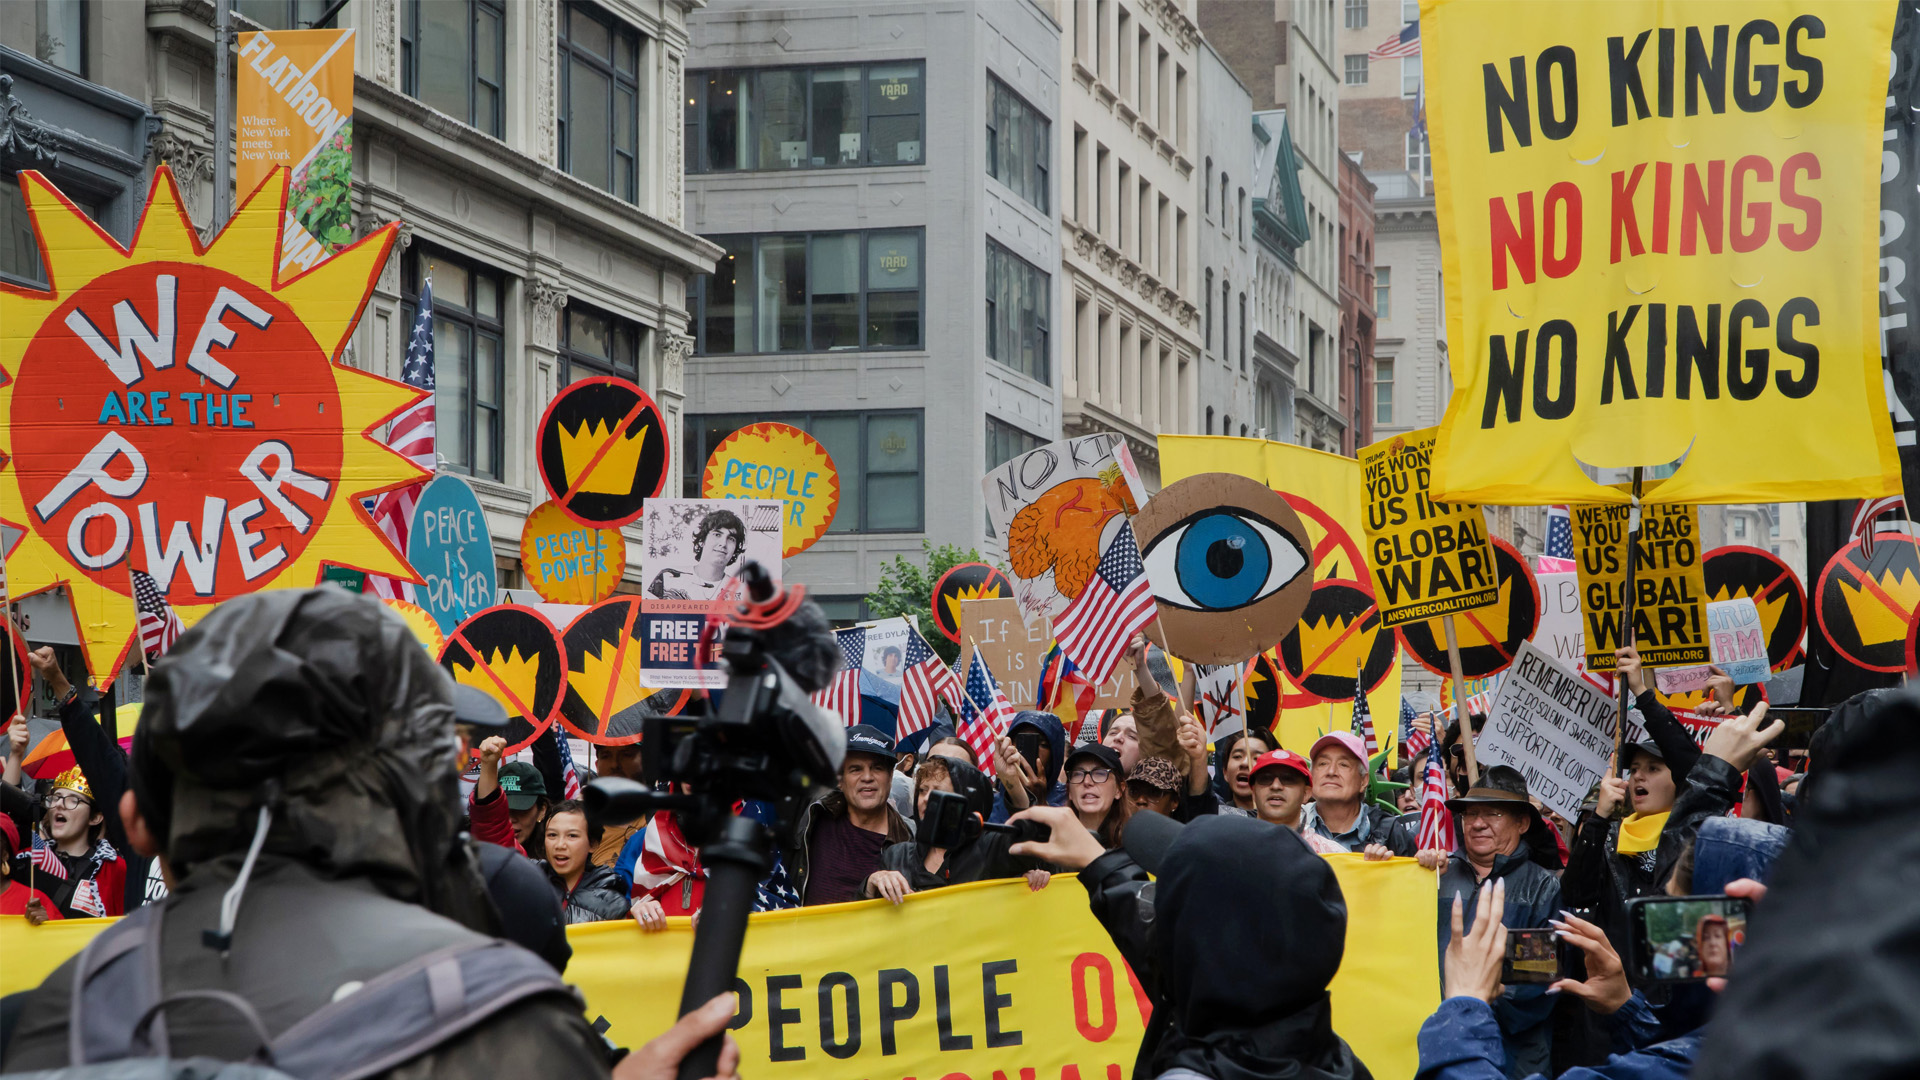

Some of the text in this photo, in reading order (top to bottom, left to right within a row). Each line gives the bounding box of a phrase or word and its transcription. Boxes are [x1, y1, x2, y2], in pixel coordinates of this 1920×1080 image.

[239, 31, 347, 141] FLATIRON
[880, 83, 908, 96] YARD
[1482, 14, 1826, 154] NO KINGS
[242, 115, 277, 126] Where
[242, 127, 291, 137] New York
[242, 139, 273, 149] meets
[242, 150, 291, 160] New York
[1489, 152, 1823, 291] NO KINGS
[880, 256, 908, 268] YARD
[64, 274, 274, 390] WE
[1480, 296, 1821, 430] NO KINGS
[99, 391, 255, 428] ARE THE
[1365, 451, 1386, 465] TRUMP
[1365, 461, 1386, 482] WE
[723, 458, 819, 499] PEOPLE
[997, 449, 1059, 512] NO
[1366, 471, 1409, 502] YOU
[34, 431, 332, 597] POWER
[424, 506, 478, 548] PEACE
[1368, 497, 1408, 530] US
[1576, 508, 1602, 525] WE
[535, 528, 608, 560] PEOPLE
[1374, 518, 1485, 566] GLOBAL
[1579, 522, 1621, 546] YOU
[444, 546, 469, 579] IS
[541, 551, 608, 584] POWER
[1376, 546, 1494, 606] WAR!
[1582, 545, 1619, 575] US
[1387, 591, 1496, 623] ANSWERCOALITION.ORG
[650, 620, 699, 640] FREE
[979, 618, 1010, 644] If
[649, 642, 688, 662] FREE
[1008, 649, 1025, 670] is
[1517, 651, 1591, 718] REMEMBER
[1501, 695, 1535, 727] I WILL
[1524, 692, 1539, 710] DO
[1568, 722, 1599, 753] SWEAR
[850, 732, 889, 749] Immigrant
[1496, 712, 1552, 760] SUPPORT
[1547, 744, 1570, 772] THE
[1488, 743, 1500, 753] OF
[1501, 749, 1516, 767] THE
[1519, 760, 1561, 800] UNITED
